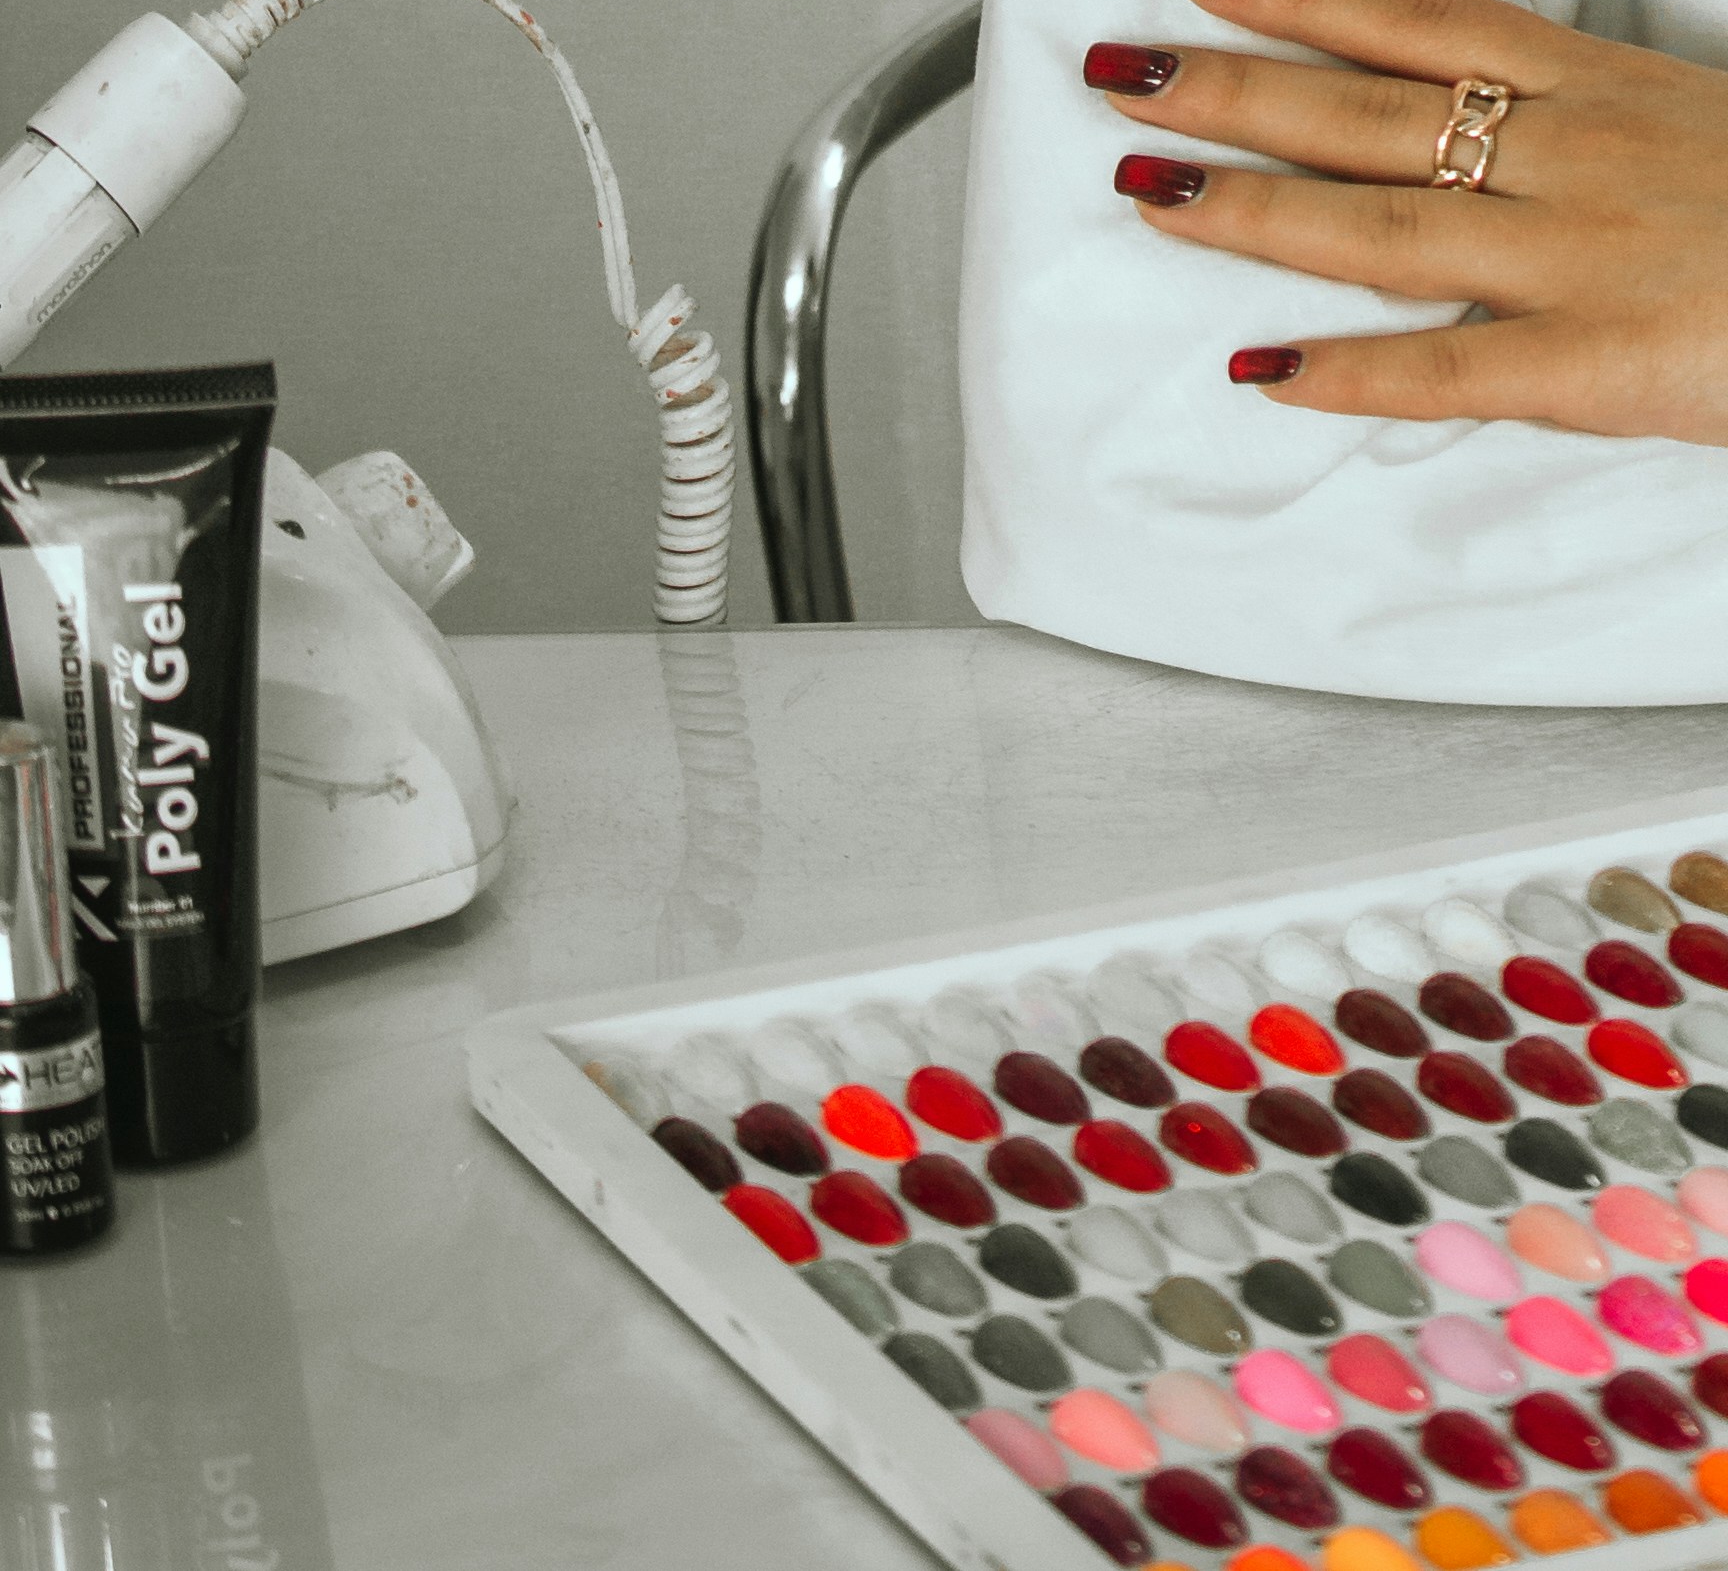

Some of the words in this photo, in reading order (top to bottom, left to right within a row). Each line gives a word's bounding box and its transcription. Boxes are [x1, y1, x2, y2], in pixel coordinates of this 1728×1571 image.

[123, 583, 189, 702] Gel
[56, 594, 95, 842] PROFESSIONAL
[137, 721, 210, 875] Poly
[5, 1132, 48, 1155] GEL
